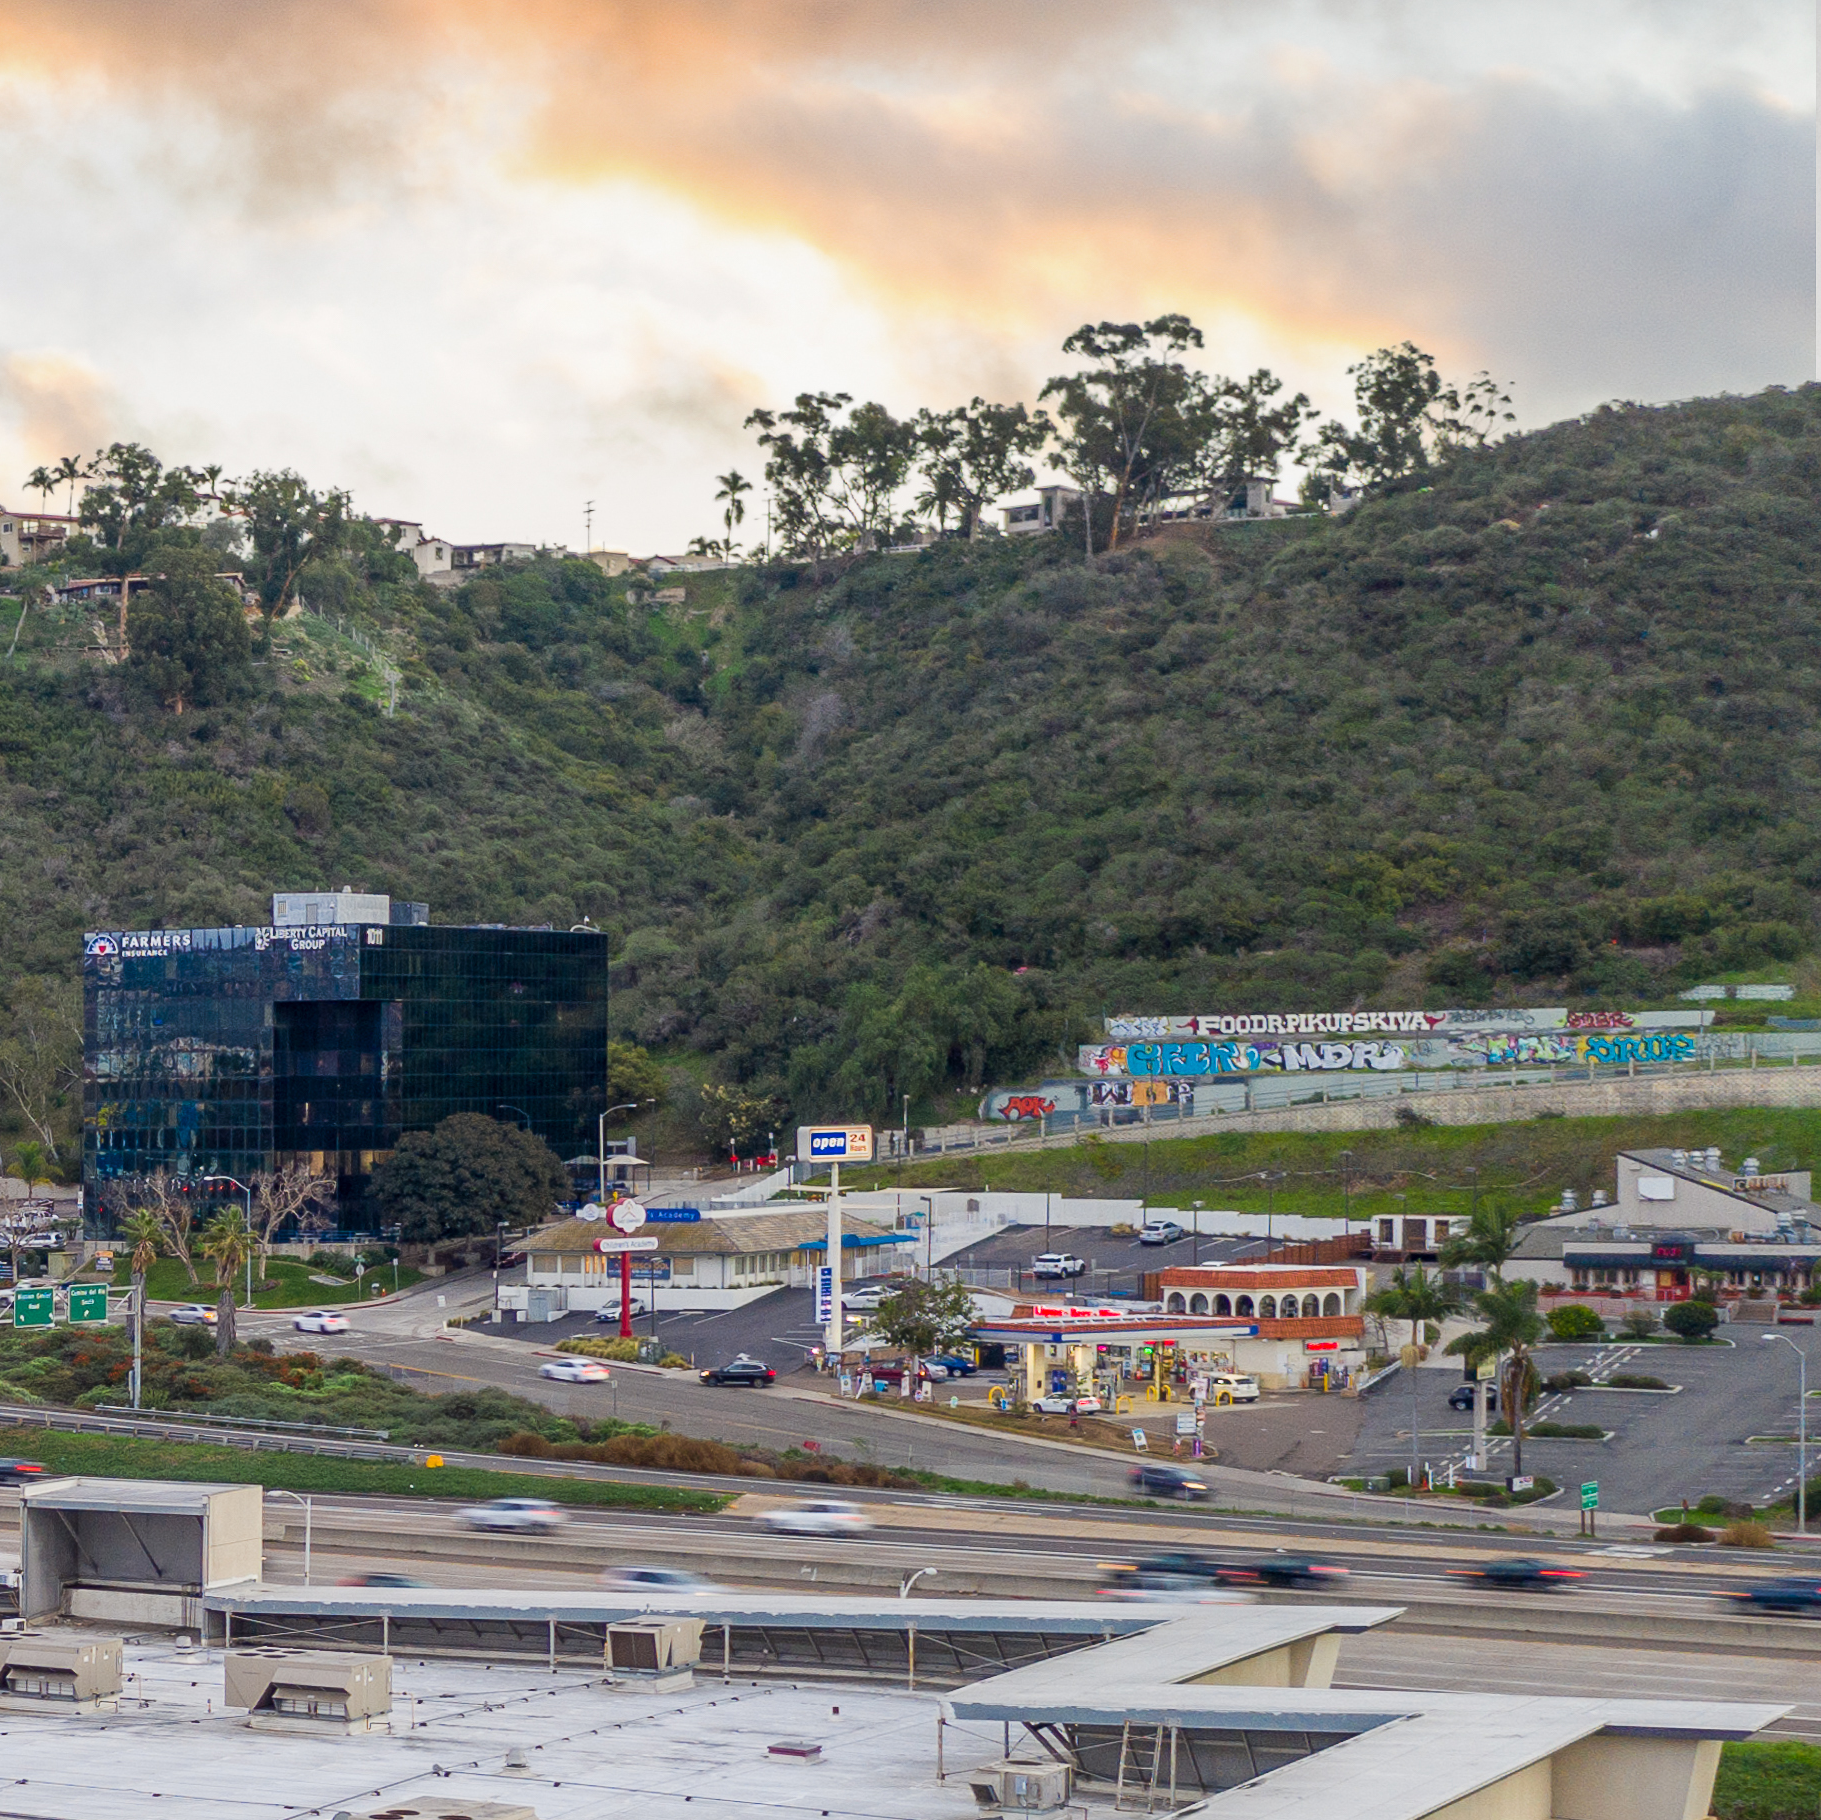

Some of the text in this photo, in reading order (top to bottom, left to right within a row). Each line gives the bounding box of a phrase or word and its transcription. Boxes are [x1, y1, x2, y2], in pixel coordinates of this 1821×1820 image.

[270, 926, 348, 940] LIBERTY CAPITAL
[366, 929, 383, 945] 1011
[122, 935, 191, 947] FARMERS
[291, 939, 325, 950] GROUP
[122, 949, 168, 957] INSURANCE
[813, 1136, 845, 1150] open
[850, 1134, 866, 1143] 24
[658, 1211, 695, 1219] Academy
